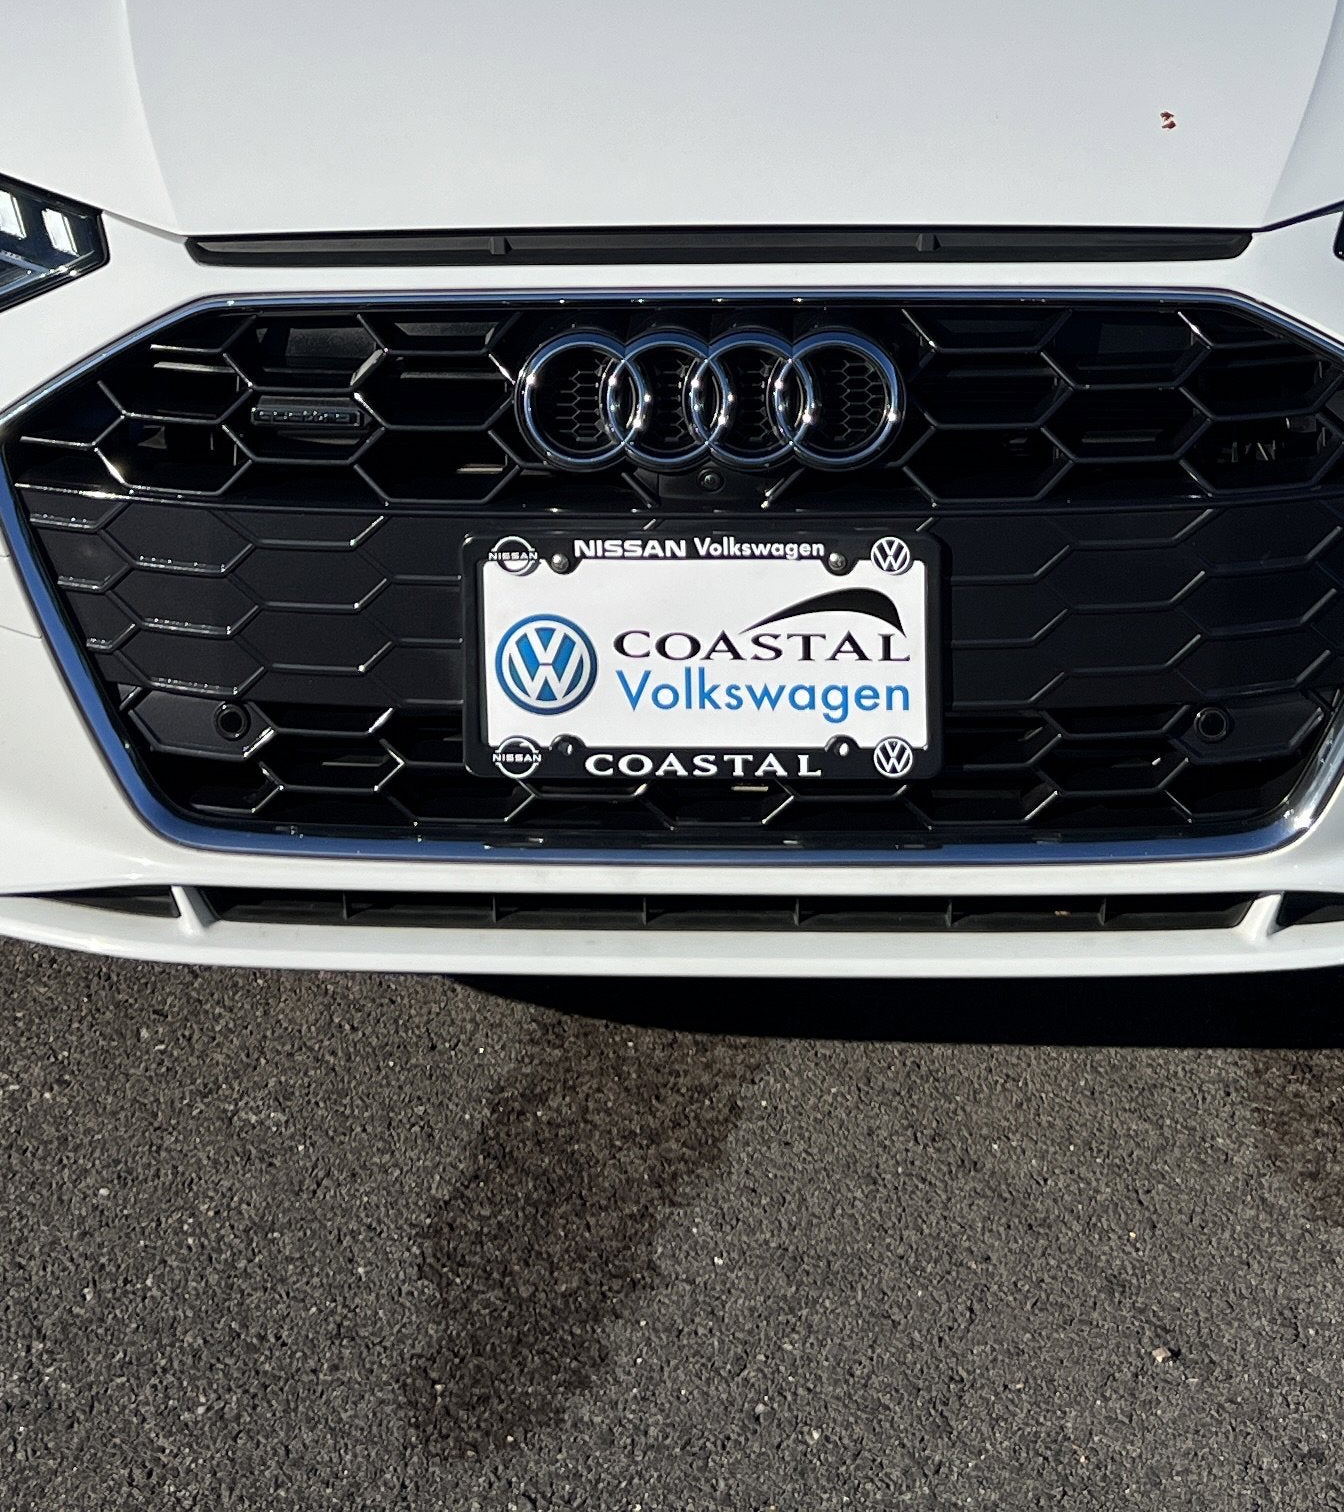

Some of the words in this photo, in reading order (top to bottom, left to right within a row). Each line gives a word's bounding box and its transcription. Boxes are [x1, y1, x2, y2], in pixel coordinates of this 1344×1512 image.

[488, 552, 538, 560] NISSAN
[574, 539, 687, 557] NISSAN
[693, 536, 825, 560] Volkswagen
[613, 629, 912, 662] COASTAL
[615, 666, 911, 724] Volkswagen
[492, 753, 542, 763] NISSAN
[584, 752, 823, 778] COASTAL
